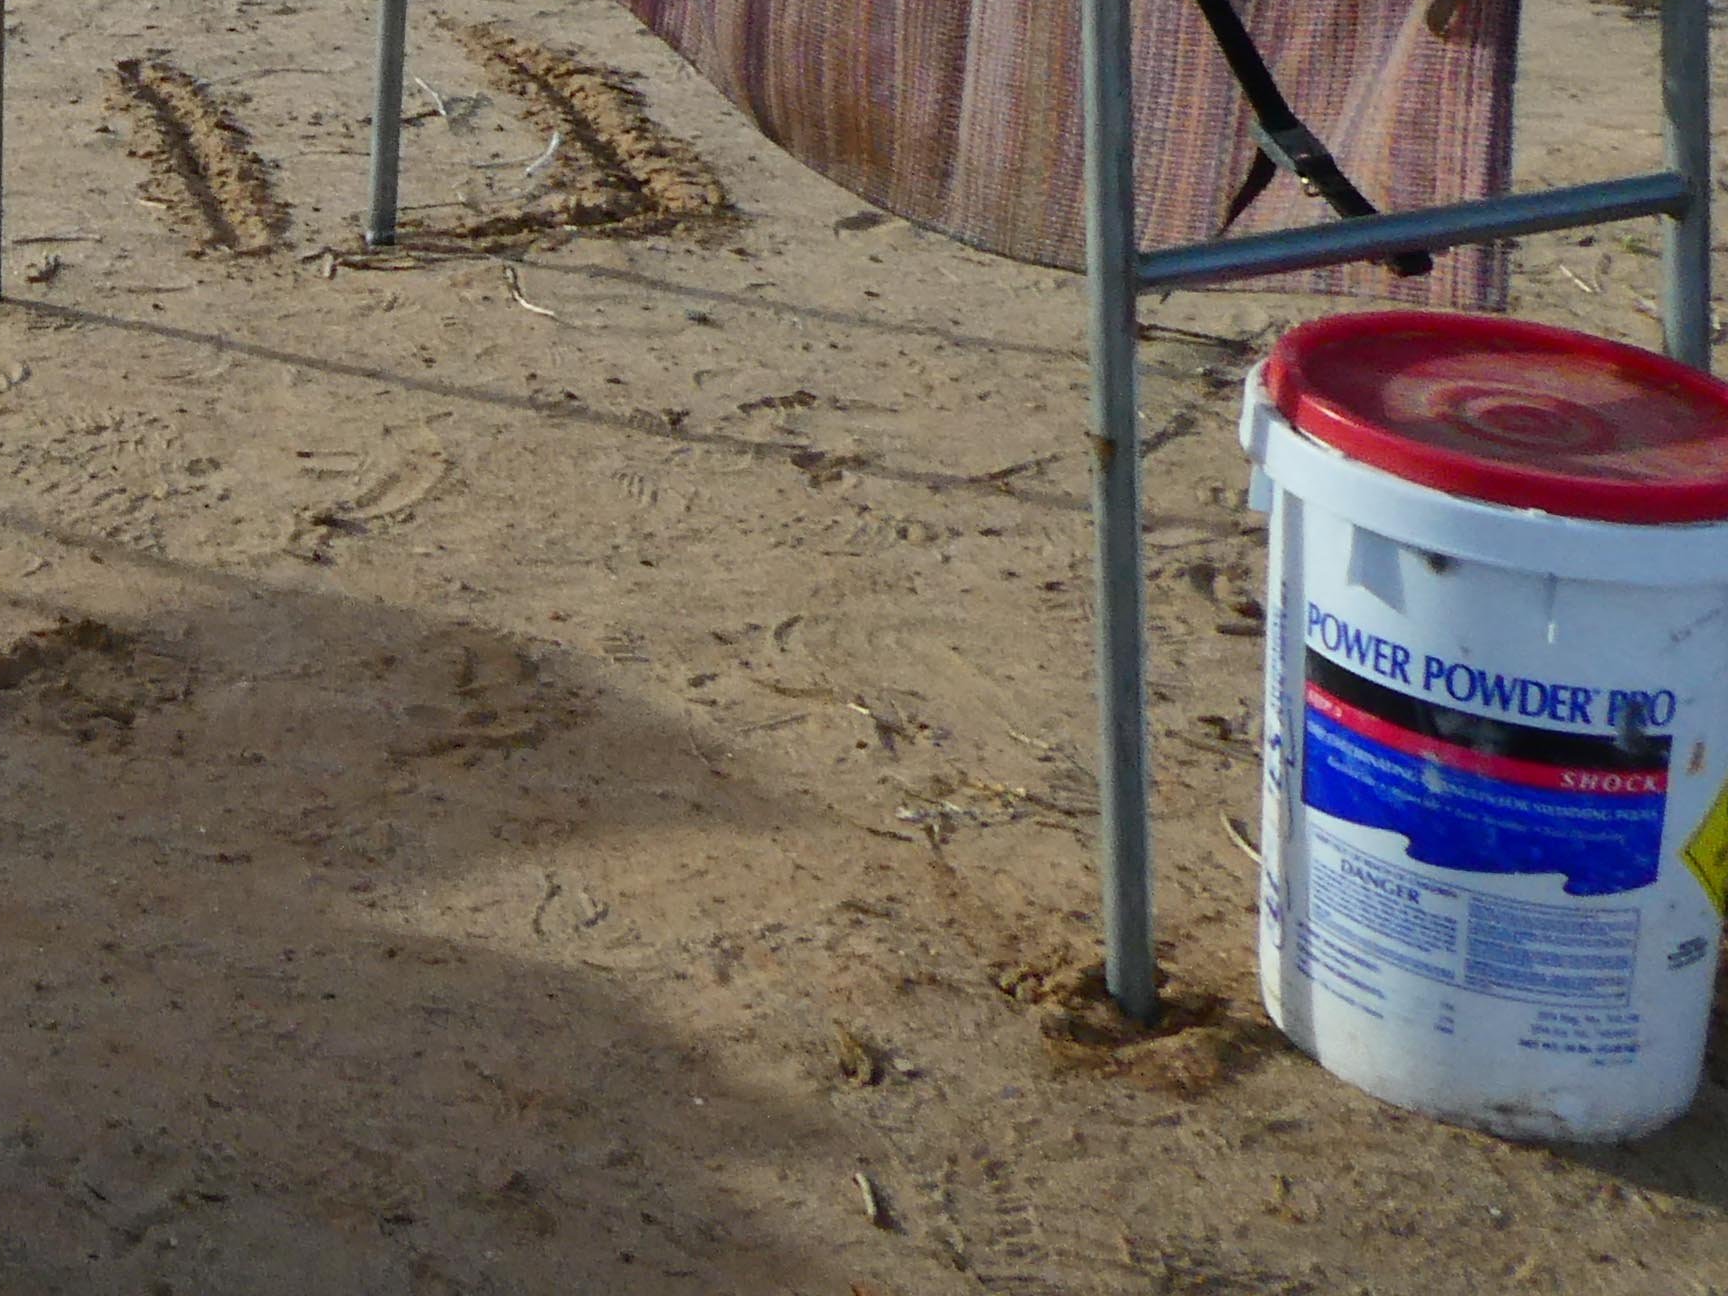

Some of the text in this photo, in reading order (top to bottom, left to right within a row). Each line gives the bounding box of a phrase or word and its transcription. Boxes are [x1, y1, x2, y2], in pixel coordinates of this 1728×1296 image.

[1307, 601, 1677, 728] POWER POWDER PRO
[1559, 769, 1661, 794] SHOCK
[1340, 858, 1421, 905] DANGER
